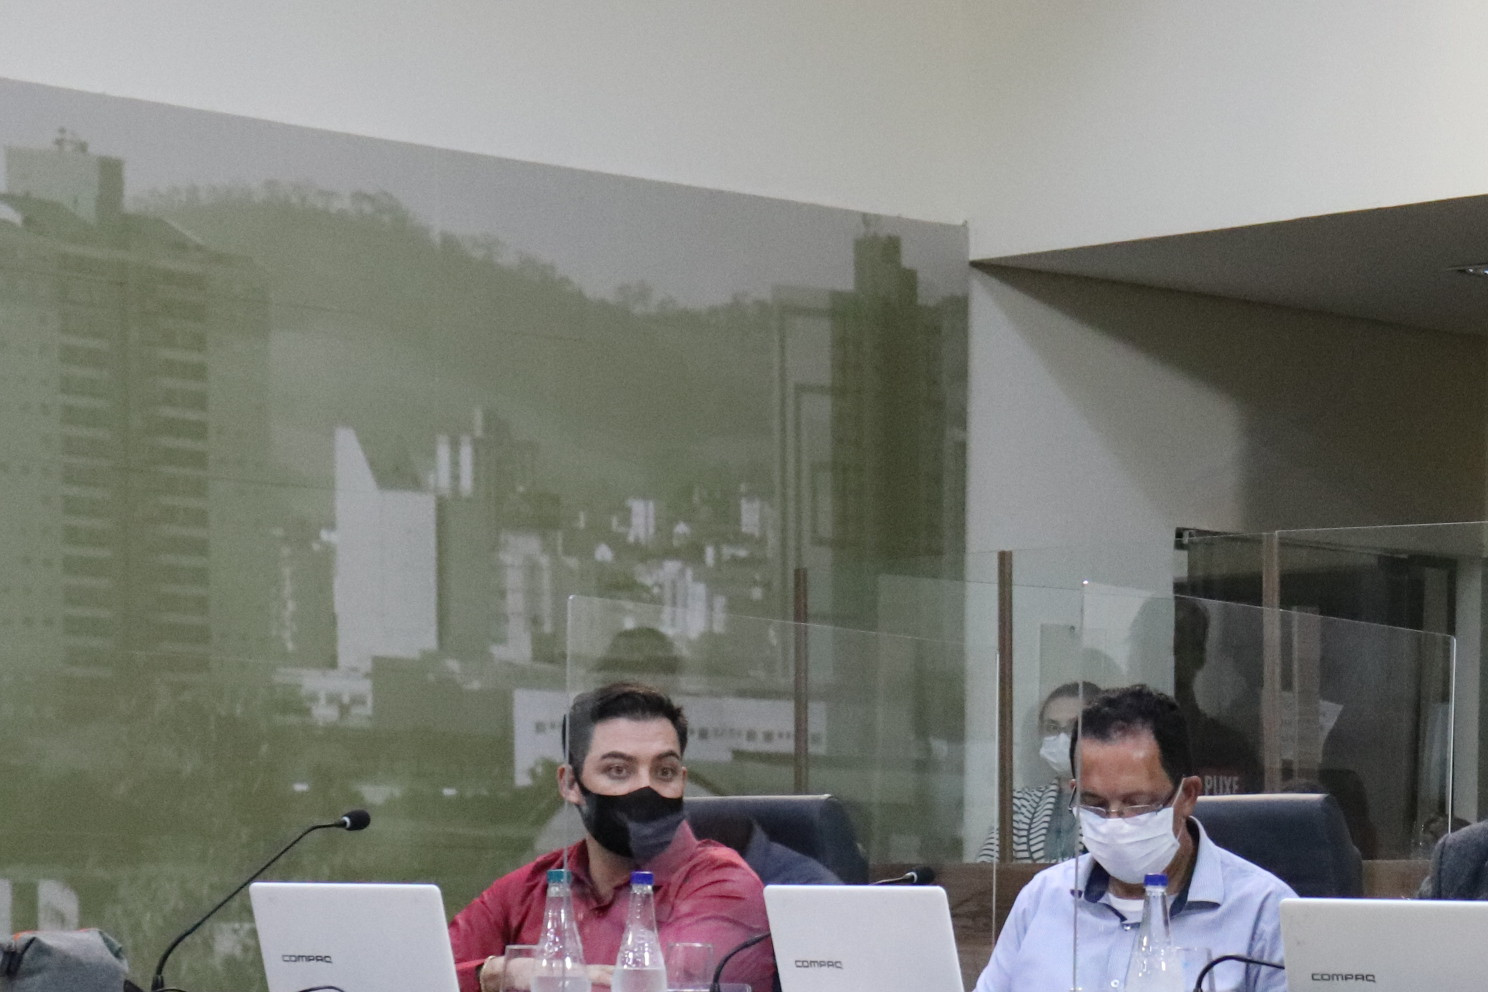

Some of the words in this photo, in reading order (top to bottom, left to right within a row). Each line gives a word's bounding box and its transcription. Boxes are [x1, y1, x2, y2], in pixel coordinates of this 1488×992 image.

[281, 954, 333, 964] COMPAQ
[795, 959, 843, 969] COMPAQ
[1311, 972, 1376, 983] COMPAQ
